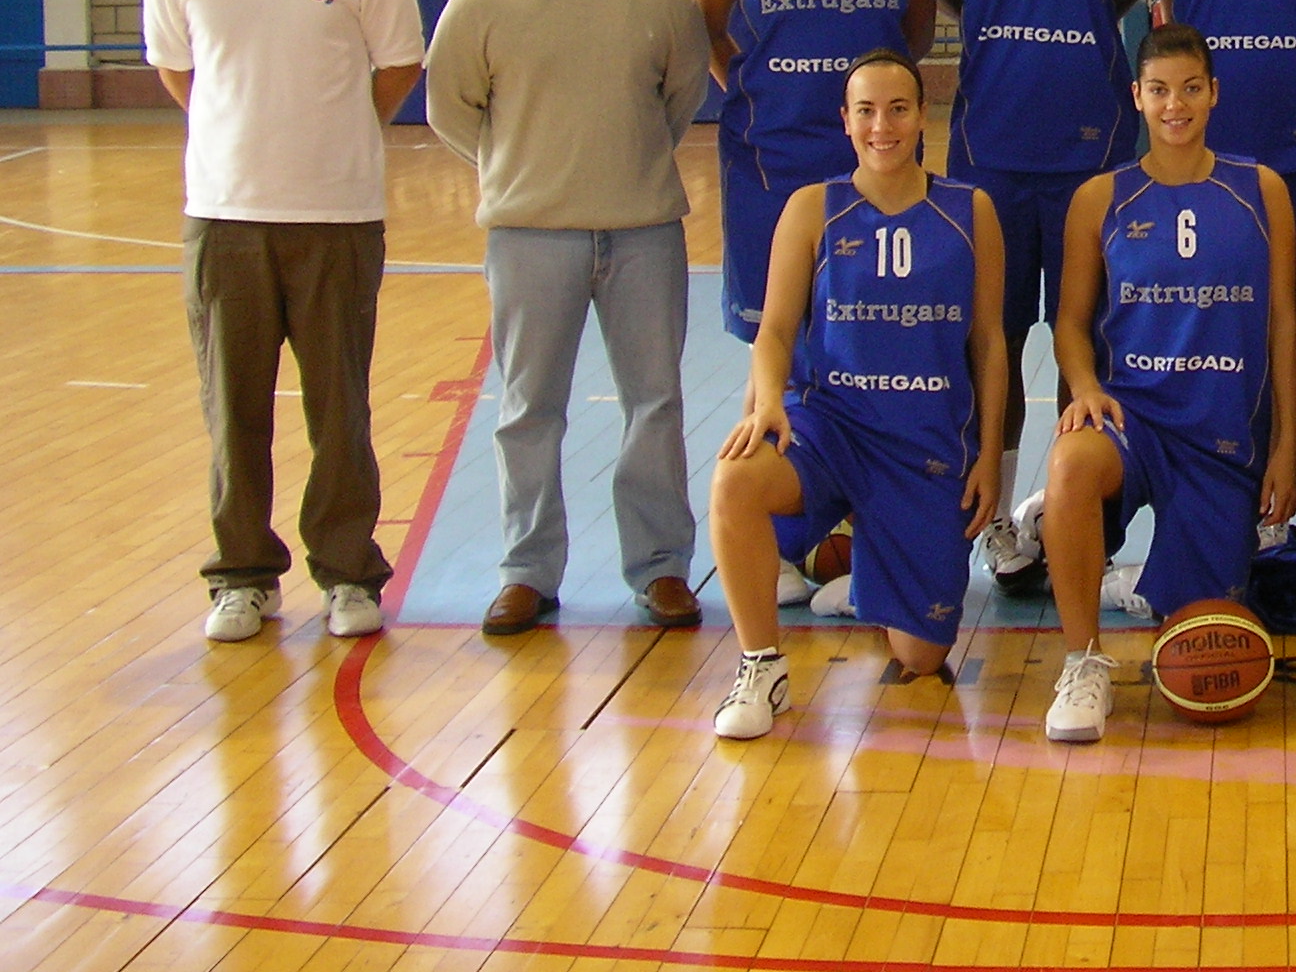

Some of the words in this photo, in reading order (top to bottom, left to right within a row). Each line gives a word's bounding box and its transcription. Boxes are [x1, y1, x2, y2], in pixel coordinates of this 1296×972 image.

[768, 56, 856, 74] CORTEG
[1176, 209, 1198, 259] 6
[875, 227, 912, 278] 10
[1118, 281, 1255, 310] Extrugasa
[826, 298, 963, 327] Extrugasa
[1125, 352, 1244, 373] CORTEGADA
